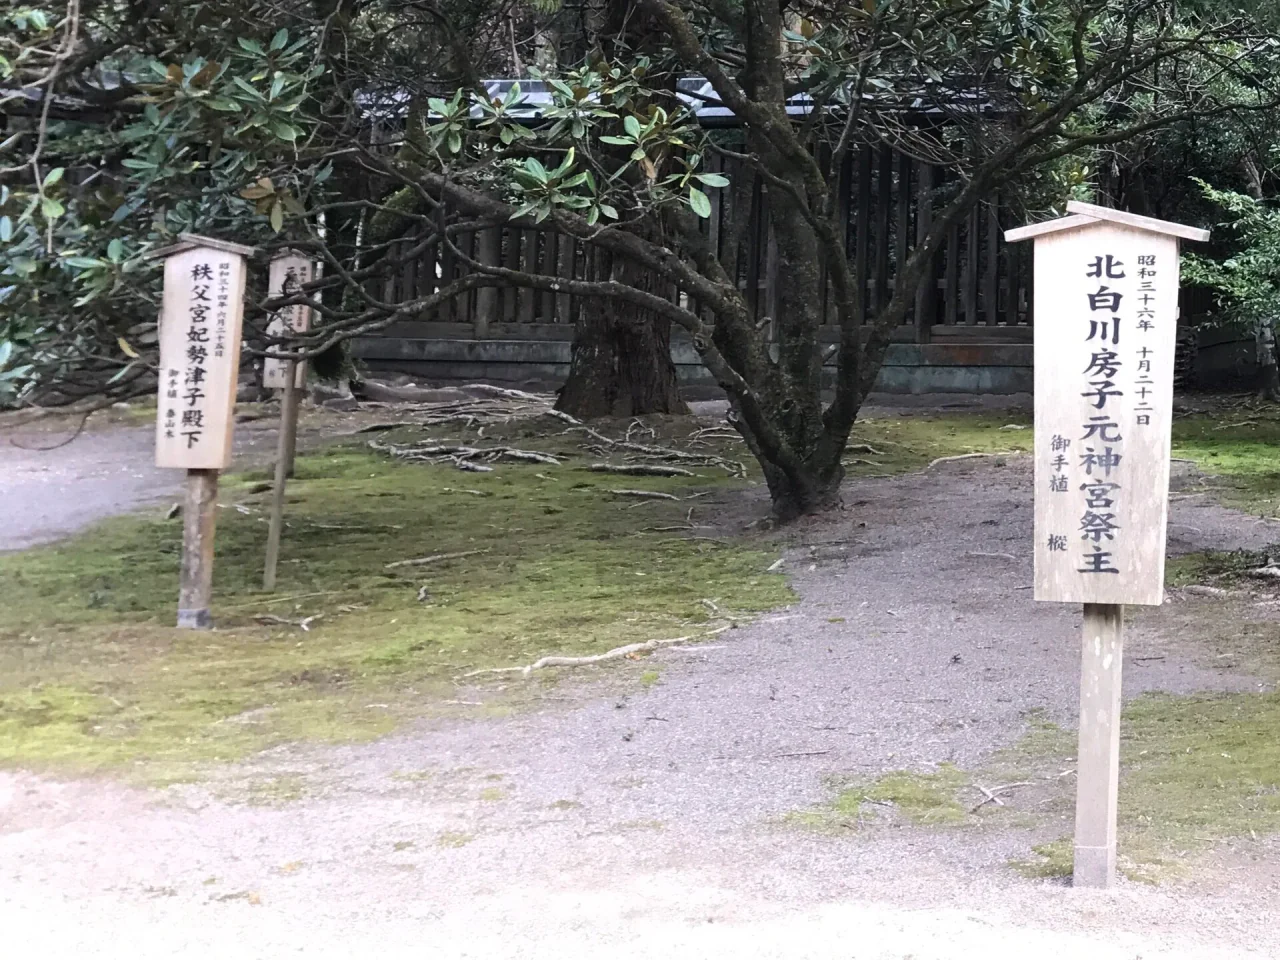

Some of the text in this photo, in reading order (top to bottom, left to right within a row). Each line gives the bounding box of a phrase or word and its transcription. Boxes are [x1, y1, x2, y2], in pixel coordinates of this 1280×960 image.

[180, 263, 214, 450] 秩父宮妃勢津子殿下
[1077, 254, 1127, 575] 北白川房子元神宮祭主
[1133, 254, 1157, 426] 昭和三十六年 十月二十二日
[1048, 433, 1071, 493] 御手植
